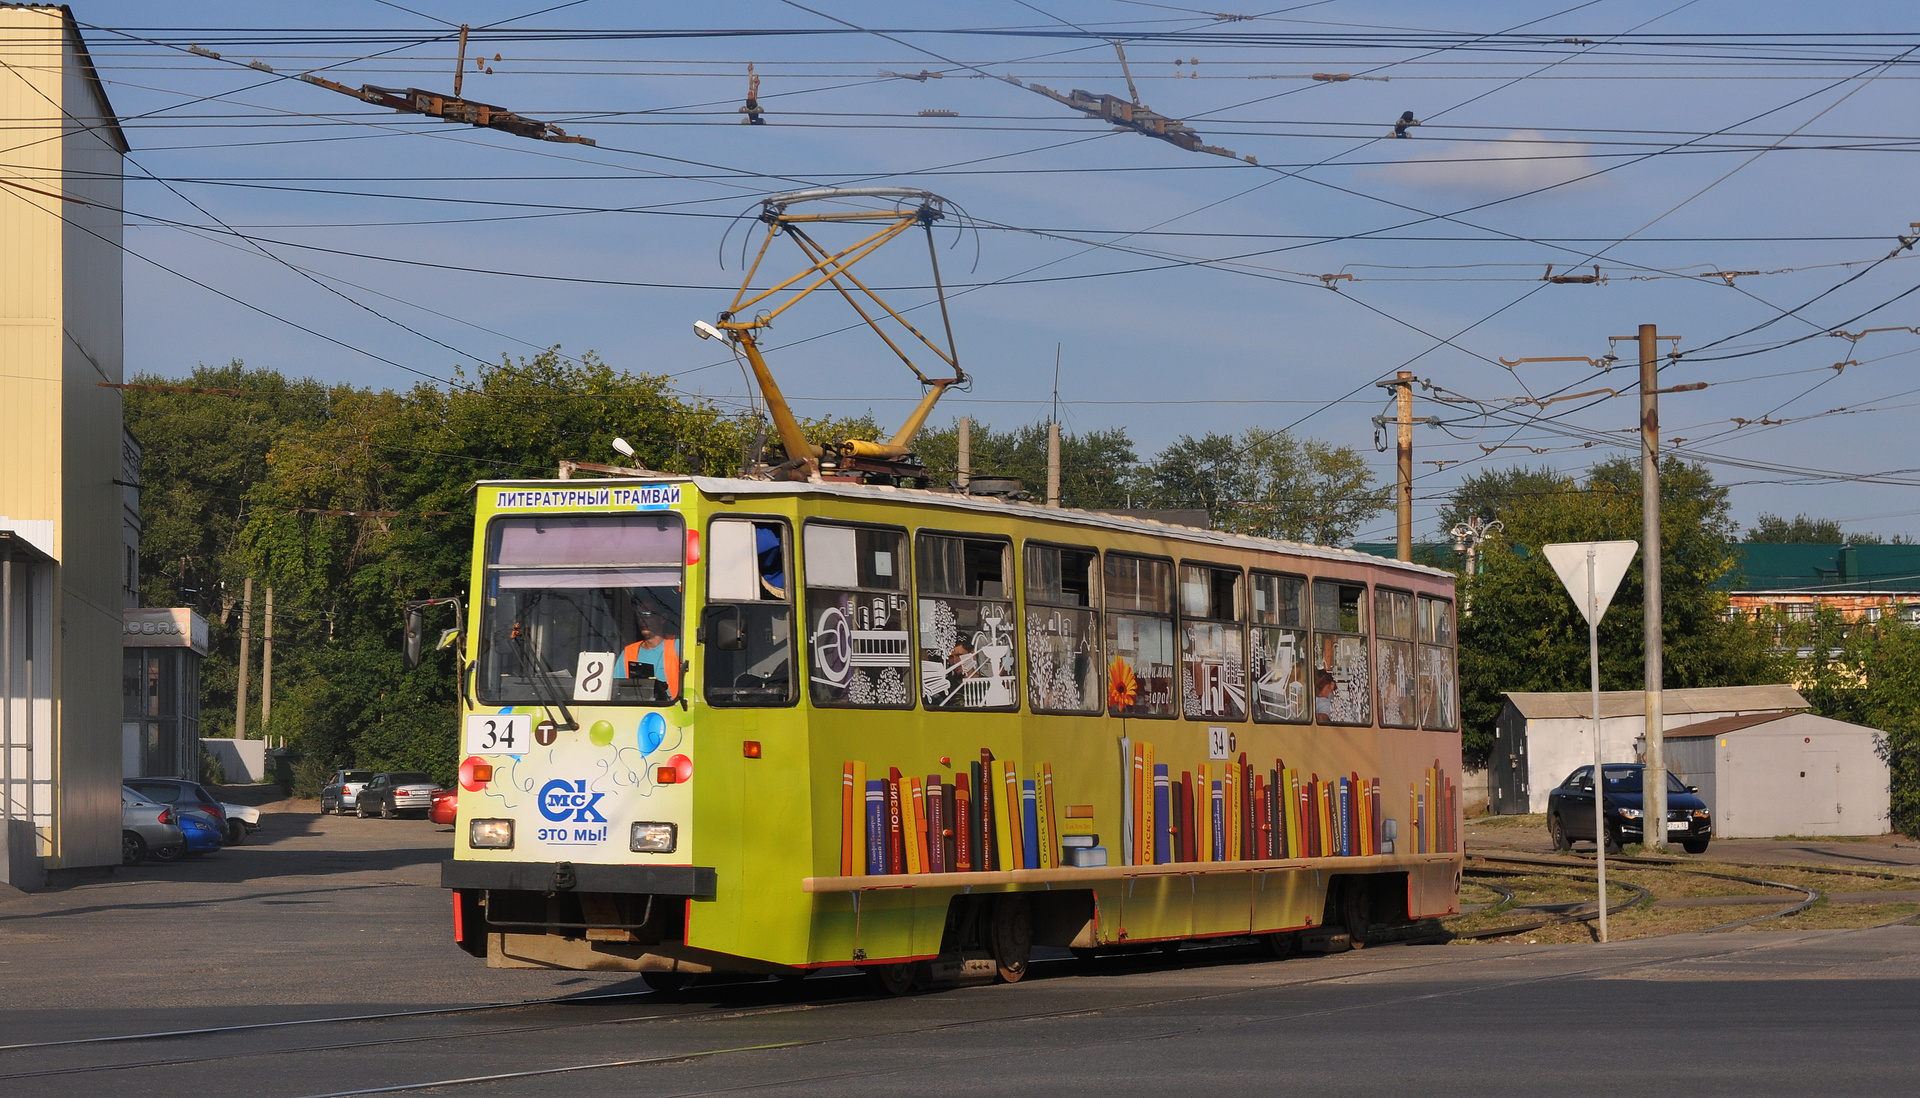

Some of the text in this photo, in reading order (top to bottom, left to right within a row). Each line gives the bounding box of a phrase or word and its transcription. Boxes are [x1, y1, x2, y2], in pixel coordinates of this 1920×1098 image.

[497, 485, 681, 507] ЛИТЕРАТУРНЫЙ ТРАМВАЙ
[123, 621, 186, 635] ОВАЯ
[582, 660, 604, 694] 8
[482, 719, 515, 749] 34
[1213, 730, 1224, 755] 34
[1036, 771, 1044, 813] лицах
[890, 782, 899, 833] ПОЭЗИЯ
